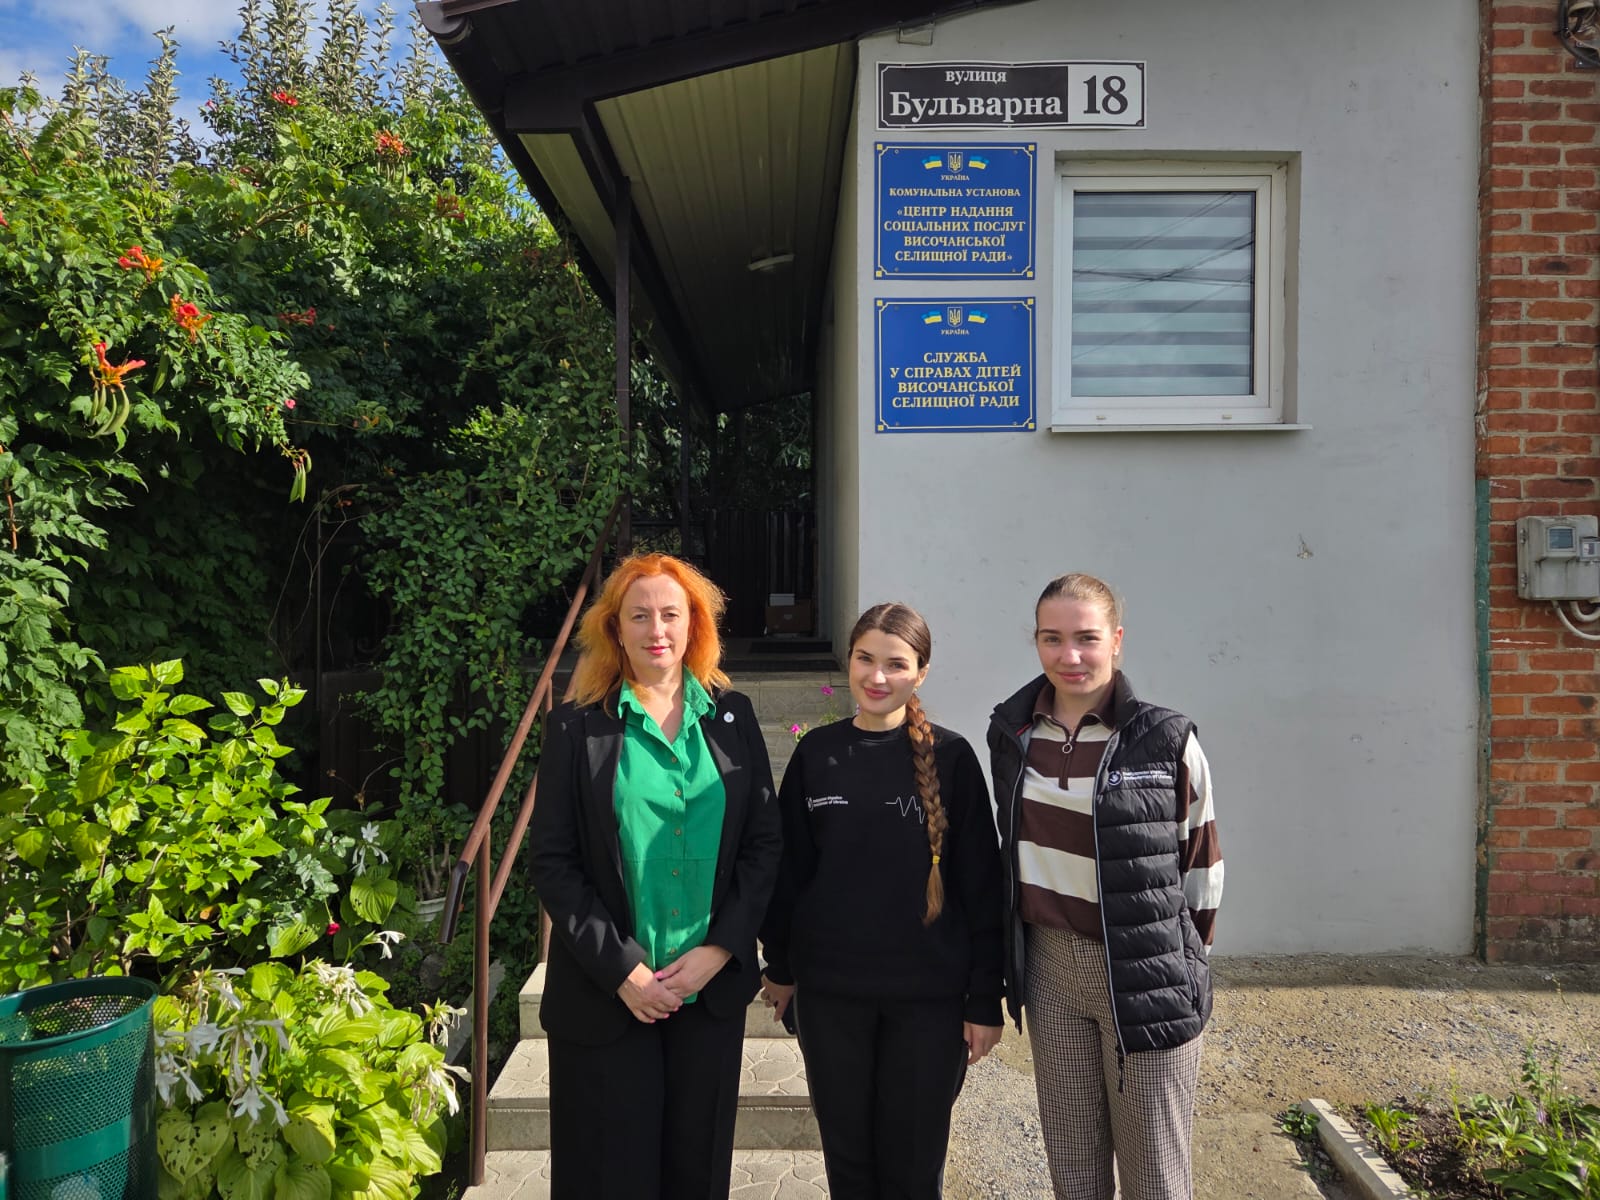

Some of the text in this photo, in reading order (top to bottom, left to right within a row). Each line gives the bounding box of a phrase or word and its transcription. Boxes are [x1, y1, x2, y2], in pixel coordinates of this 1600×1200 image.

[946, 70, 1007, 85] вулиця
[1083, 75, 1129, 115] 18
[890, 91, 1062, 122] Бульварна
[889, 188, 1021, 197] КОМУНАЛЬНА УСТАНОВА
[897, 206, 1014, 218] «ЦЕНТР НАДАННЯ
[883, 221, 1026, 232] СОЦІАЛЬНИХ ПОСЛУГ
[904, 234, 1006, 247] ВИСОЧАНСЬКОЇ
[895, 249, 1012, 262] СЕЛИЩНОЇ РАДИ»
[923, 352, 988, 363] СЛУЖБА
[889, 363, 1022, 379] У СПРАВАХ ДІТЕЙ
[897, 378, 1015, 393] ВИСОЧАНСЬКОЇ
[892, 394, 1021, 408] СЕЛИЩНОЇ РАДИ
